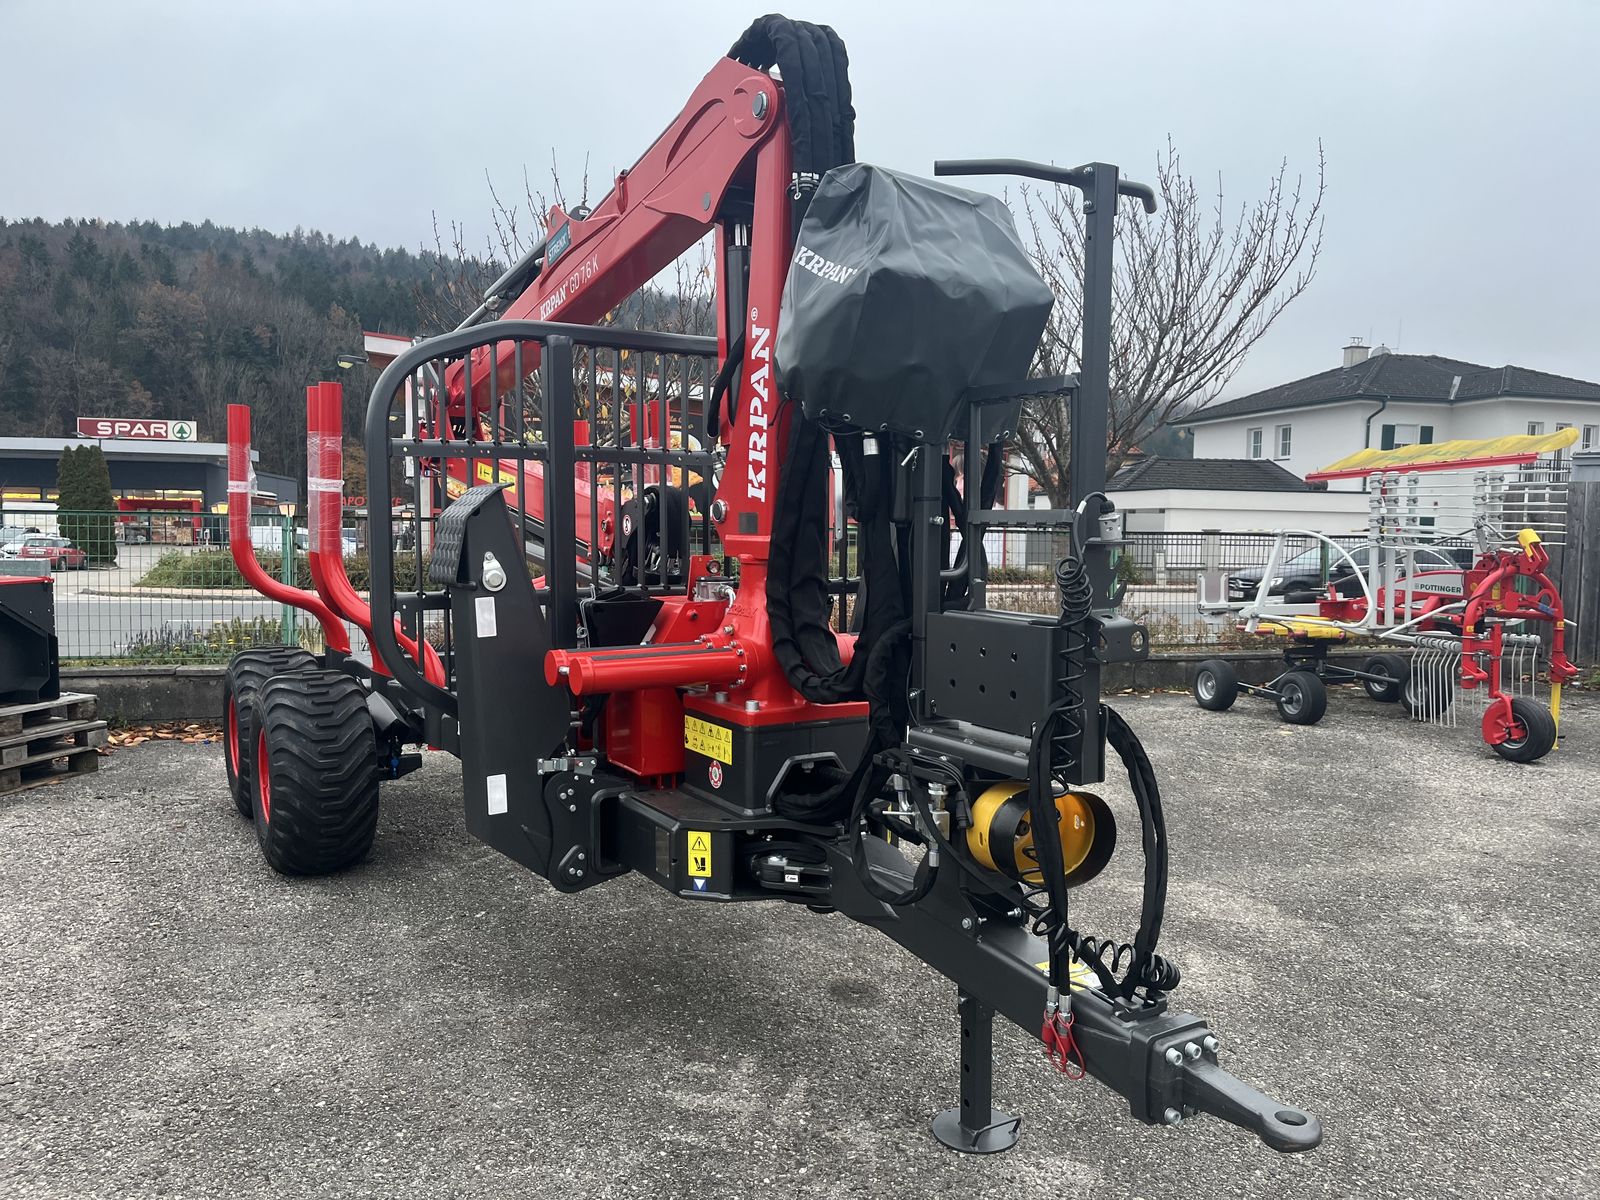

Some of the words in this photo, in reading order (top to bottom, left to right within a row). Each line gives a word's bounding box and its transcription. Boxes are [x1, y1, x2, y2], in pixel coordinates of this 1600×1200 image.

[569, 273, 580, 294] GD
[593, 254, 599, 271] K
[794, 245, 853, 284] KRPAN
[96, 421, 167, 437] SPAR
